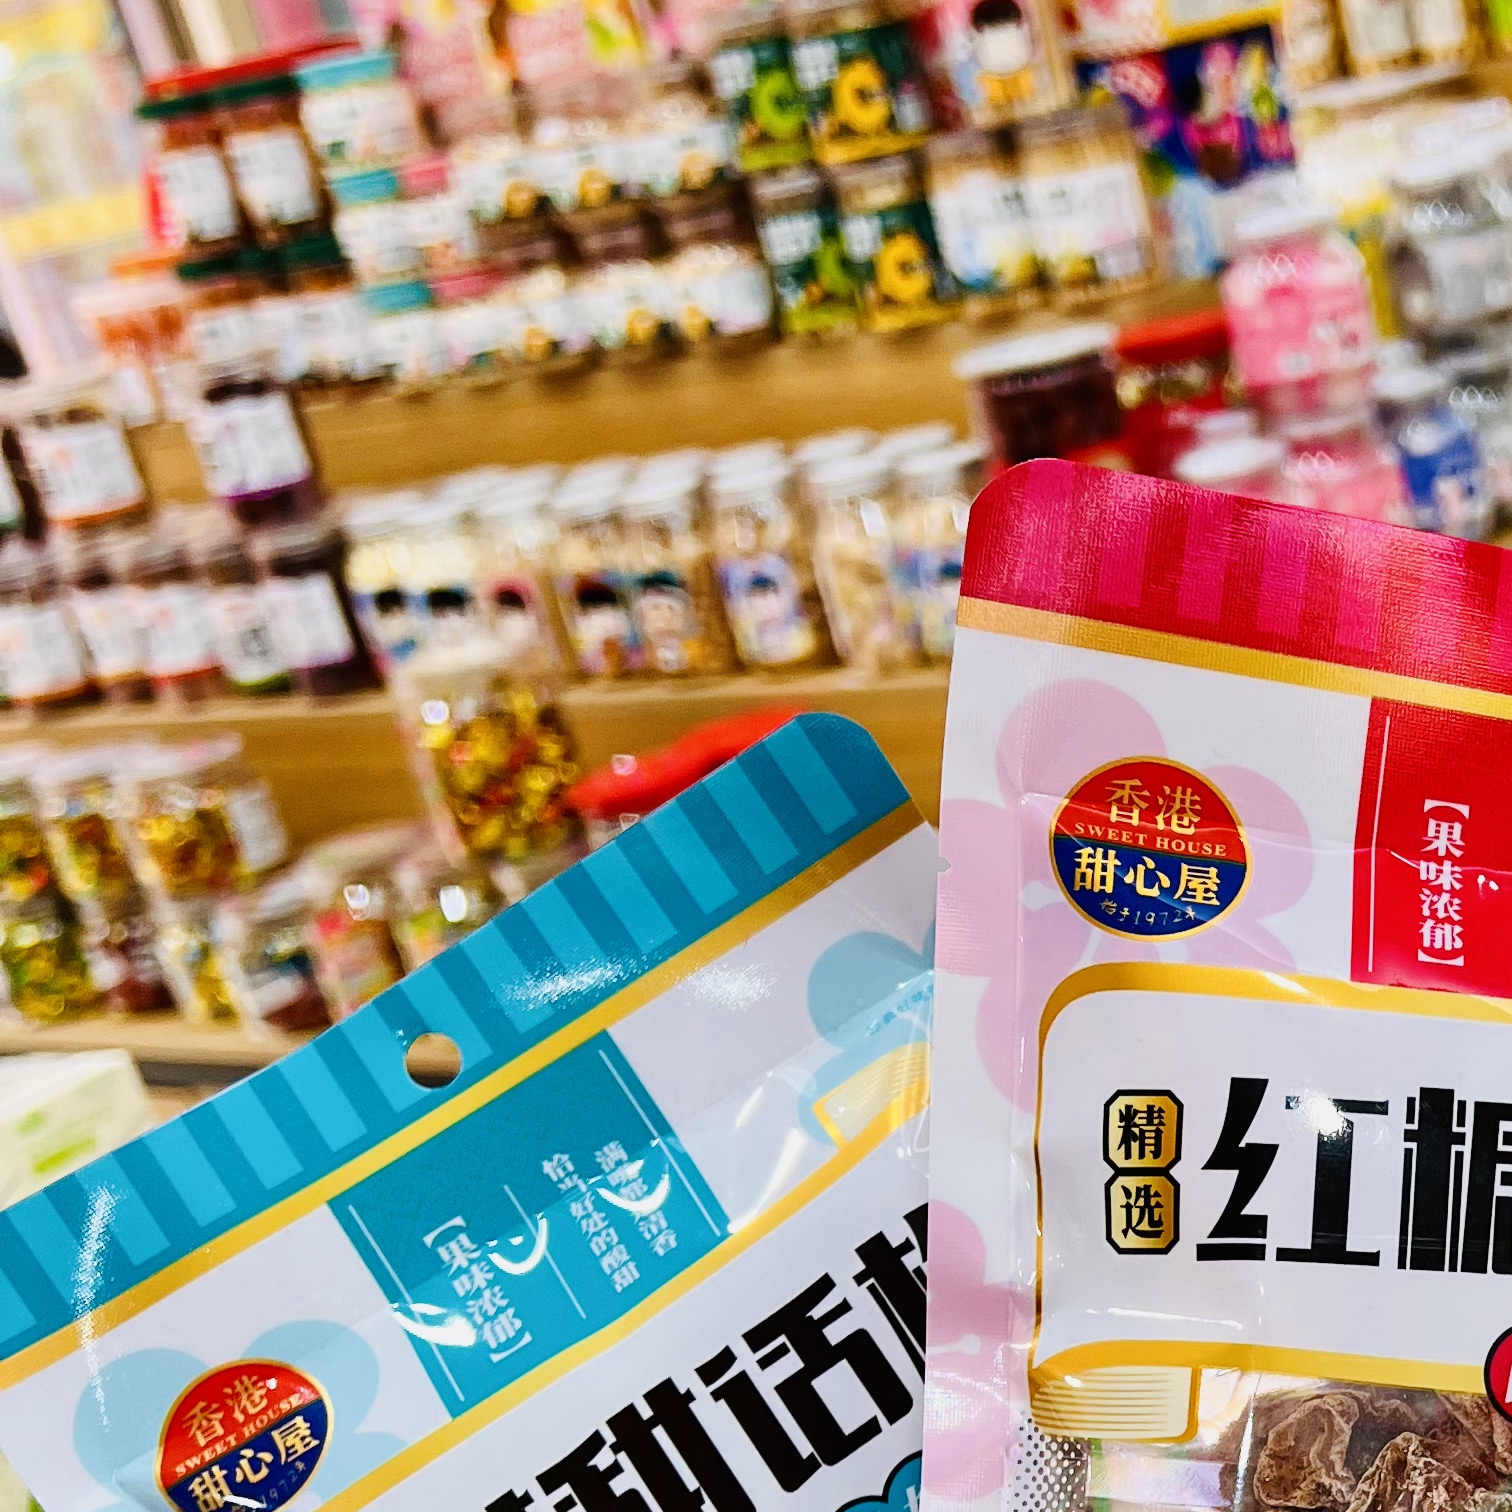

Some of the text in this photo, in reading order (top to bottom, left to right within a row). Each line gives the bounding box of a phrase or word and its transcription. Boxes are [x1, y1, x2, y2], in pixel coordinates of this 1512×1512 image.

[1074, 822, 1227, 857] SWEET HOUSE
[1104, 778, 1202, 835] 香港
[1073, 847, 1221, 906] 甜心屋
[1117, 1104, 1166, 1240] 精选
[541, 1152, 641, 1294] 恰当好处的酸甜
[175, 1391, 303, 1479] SWEET HOUSE
[182, 1375, 269, 1448] 香港
